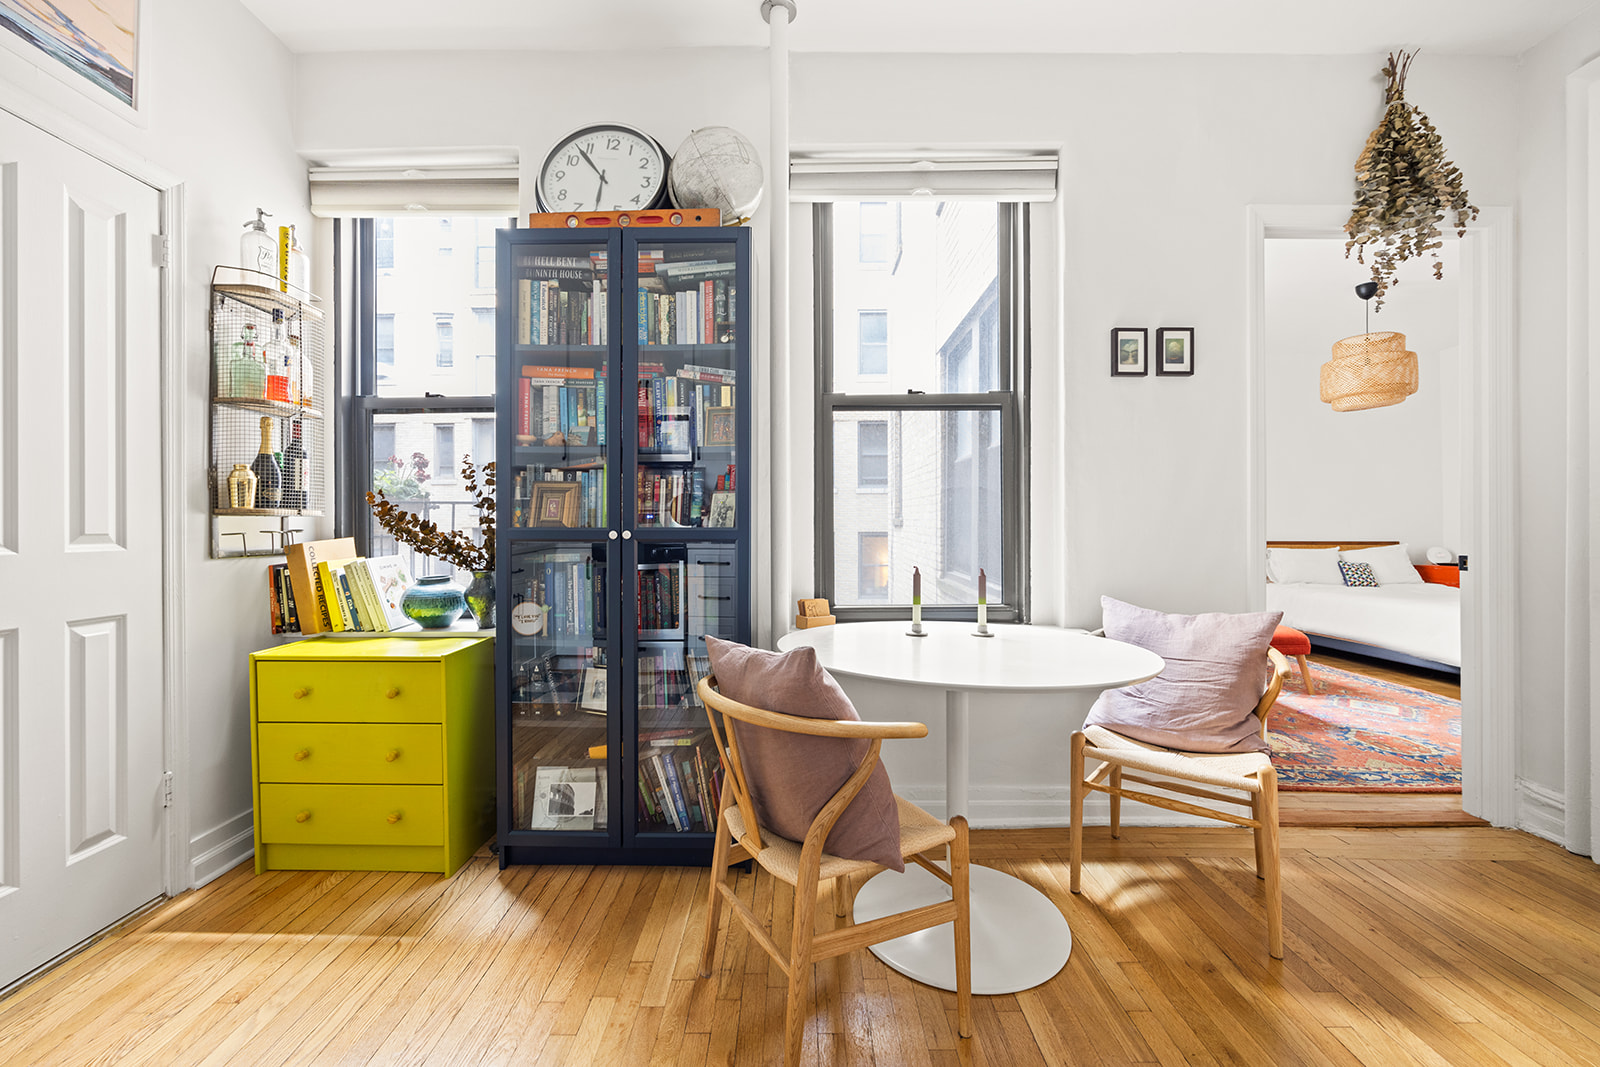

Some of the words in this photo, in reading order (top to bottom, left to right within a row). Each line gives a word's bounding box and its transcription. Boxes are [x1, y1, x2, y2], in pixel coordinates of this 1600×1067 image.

[586, 142, 594, 154] 11
[606, 138, 620, 150] 12
[629, 144, 633, 156] 1
[566, 154, 580, 166] 10
[639, 158, 649, 169] 2
[555, 170, 565, 182] 9
[640, 176, 651, 188] 3
[557, 189, 567, 201] 8
[630, 194, 640, 205] 4
[534, 256, 555, 266] HELL
[556, 256, 577, 267] BENT
[535, 269, 558, 278] NINTH
[560, 270, 582, 279] HOUSE
[309, 546, 322, 592] COLLECTED
[318, 594, 329, 628] RECIPES
